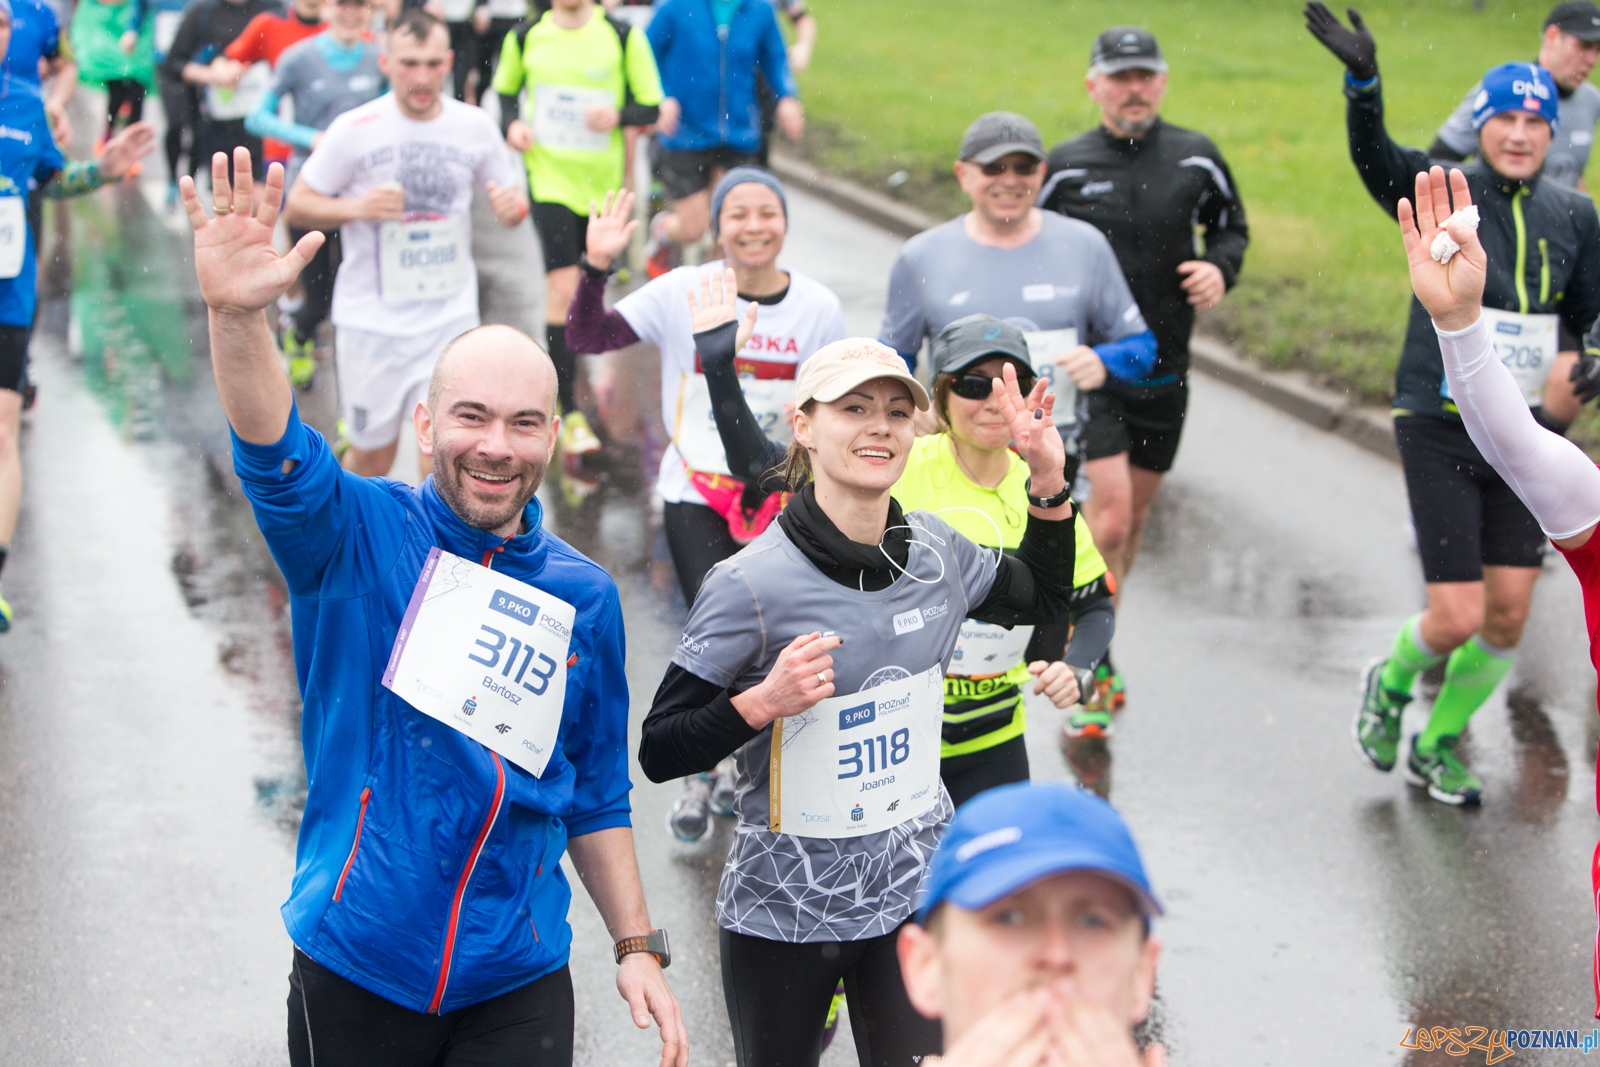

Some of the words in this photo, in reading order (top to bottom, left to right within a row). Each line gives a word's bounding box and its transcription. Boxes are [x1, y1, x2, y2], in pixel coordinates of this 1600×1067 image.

[1493, 342, 1543, 369] 208
[958, 629, 1005, 640] Agnieszka
[468, 624, 557, 696] 3113
[482, 675, 523, 706] Bartosz
[494, 722, 512, 735] 4F
[837, 727, 910, 780] 3118
[859, 774, 896, 793] Joanna
[886, 798, 901, 812] 4F
